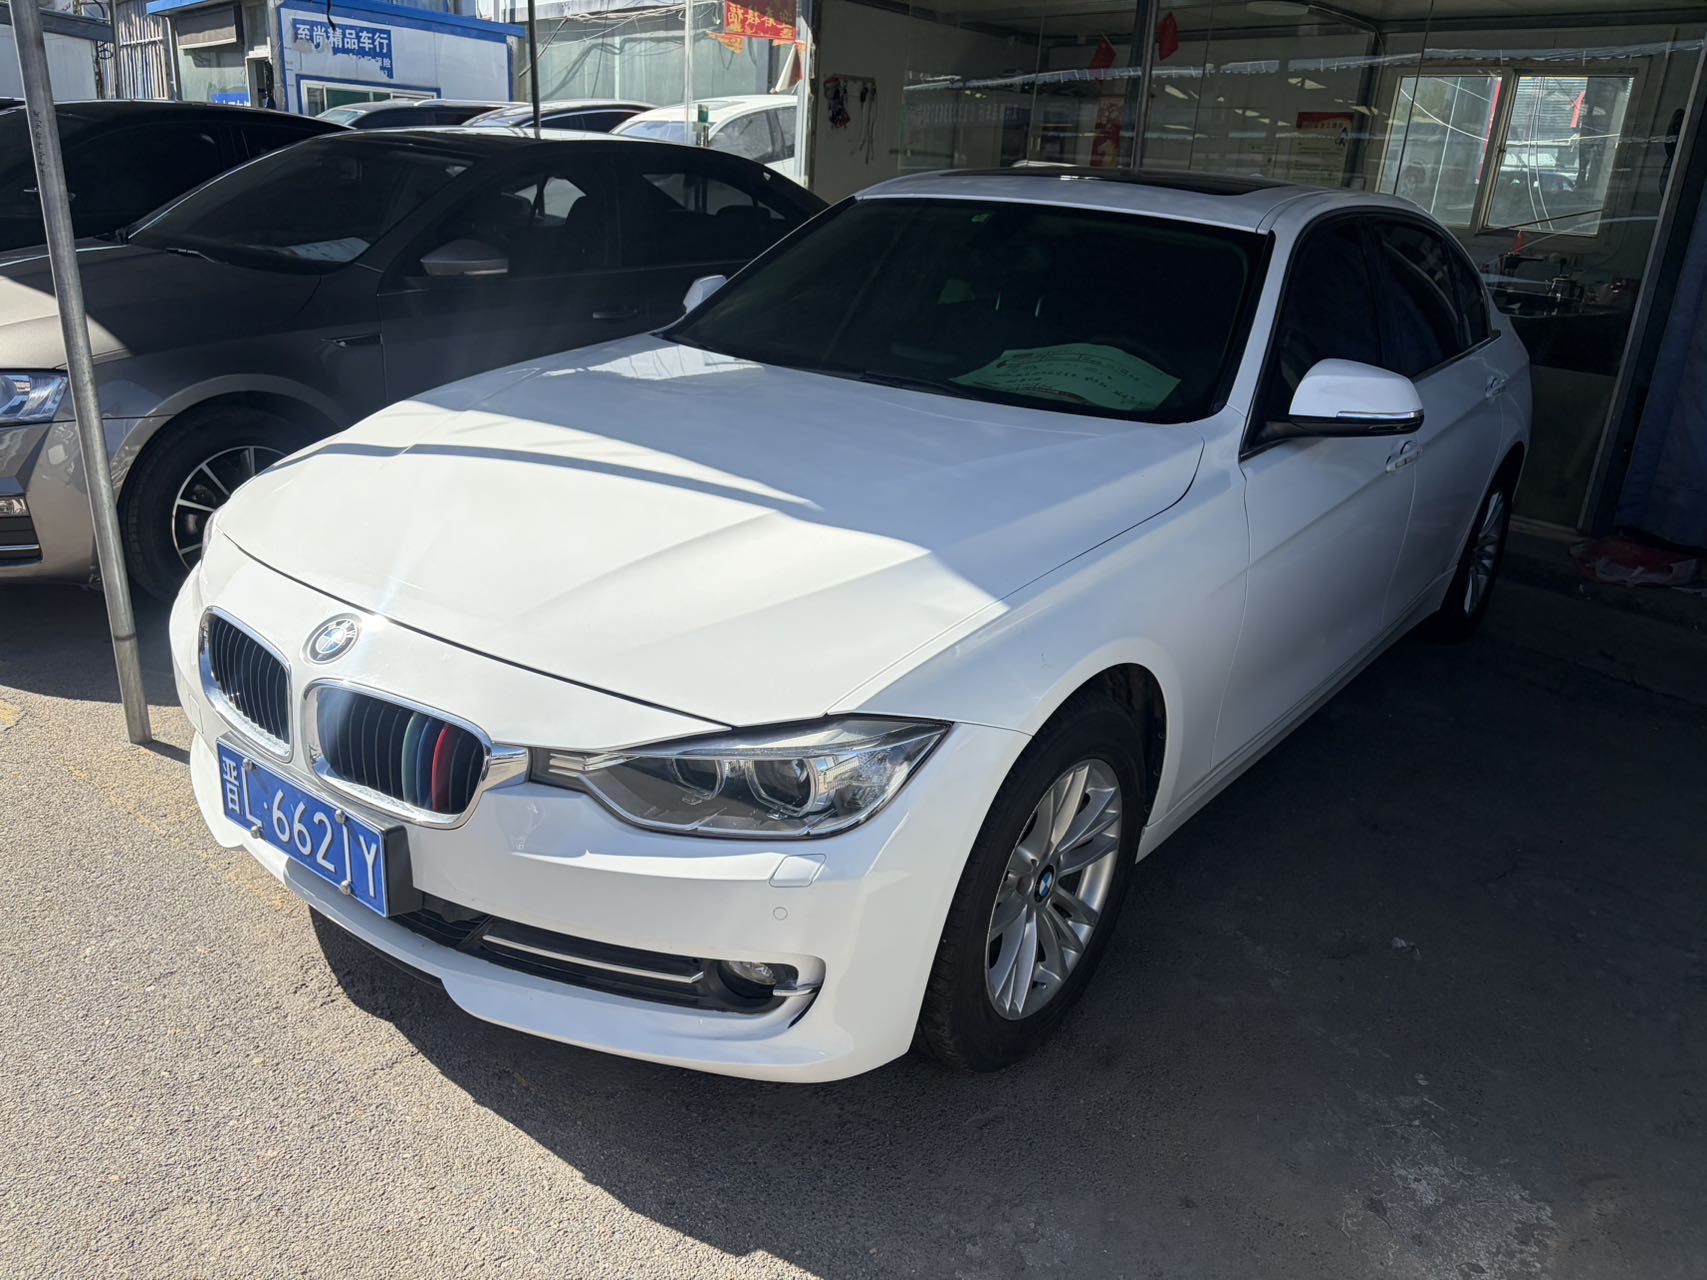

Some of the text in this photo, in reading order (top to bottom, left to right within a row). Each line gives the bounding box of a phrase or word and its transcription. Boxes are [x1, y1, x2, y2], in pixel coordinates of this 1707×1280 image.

[296, 25, 388, 53] 至尚精品车行
